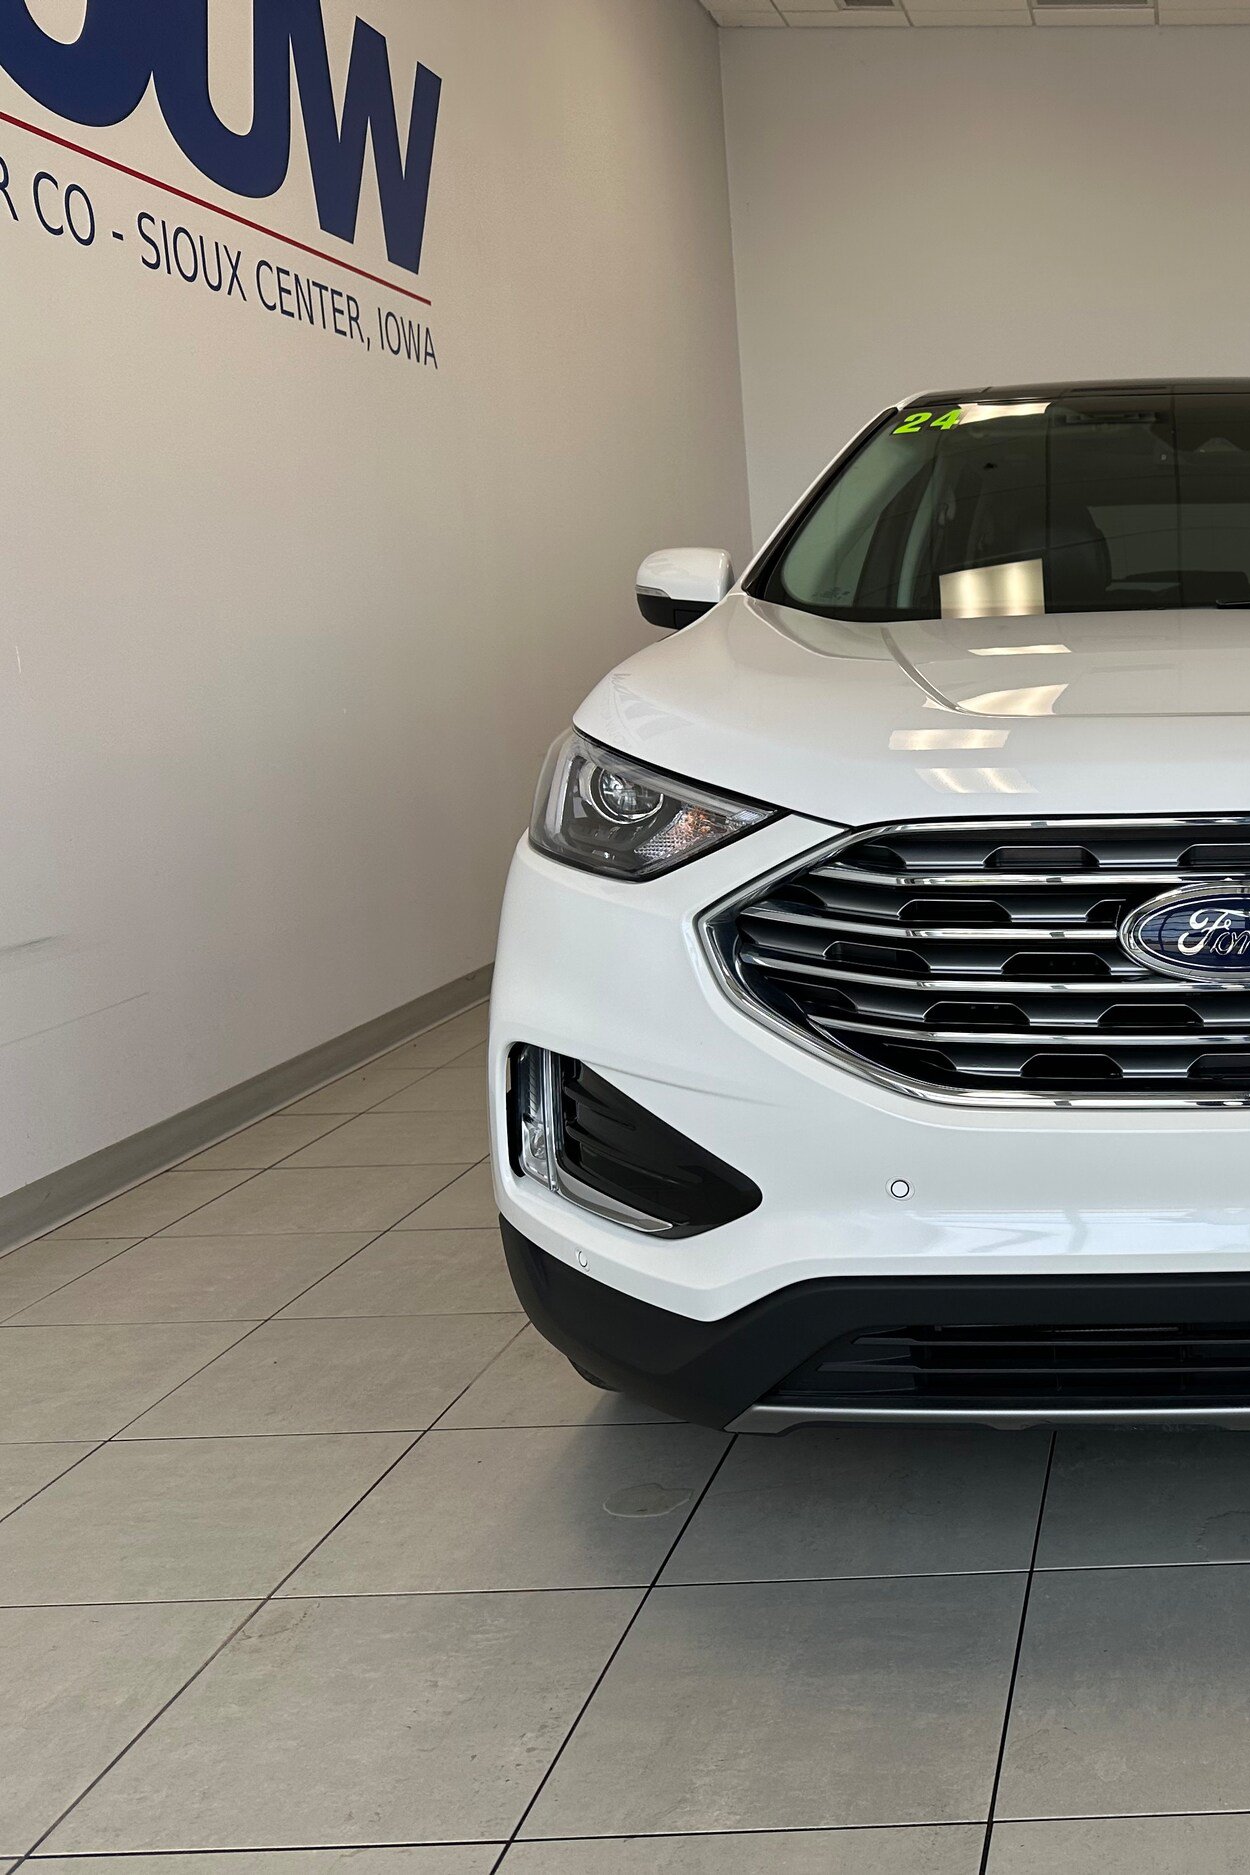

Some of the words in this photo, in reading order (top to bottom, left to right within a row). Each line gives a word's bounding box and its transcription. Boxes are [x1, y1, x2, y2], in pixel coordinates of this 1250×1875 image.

[33, 171, 95, 247] CO
[112, 230, 124, 241] -
[137, 211, 247, 302] SIOUX
[256, 259, 372, 352] CENTER,
[377, 307, 438, 370] IOWA
[892, 408, 962, 435] 24
